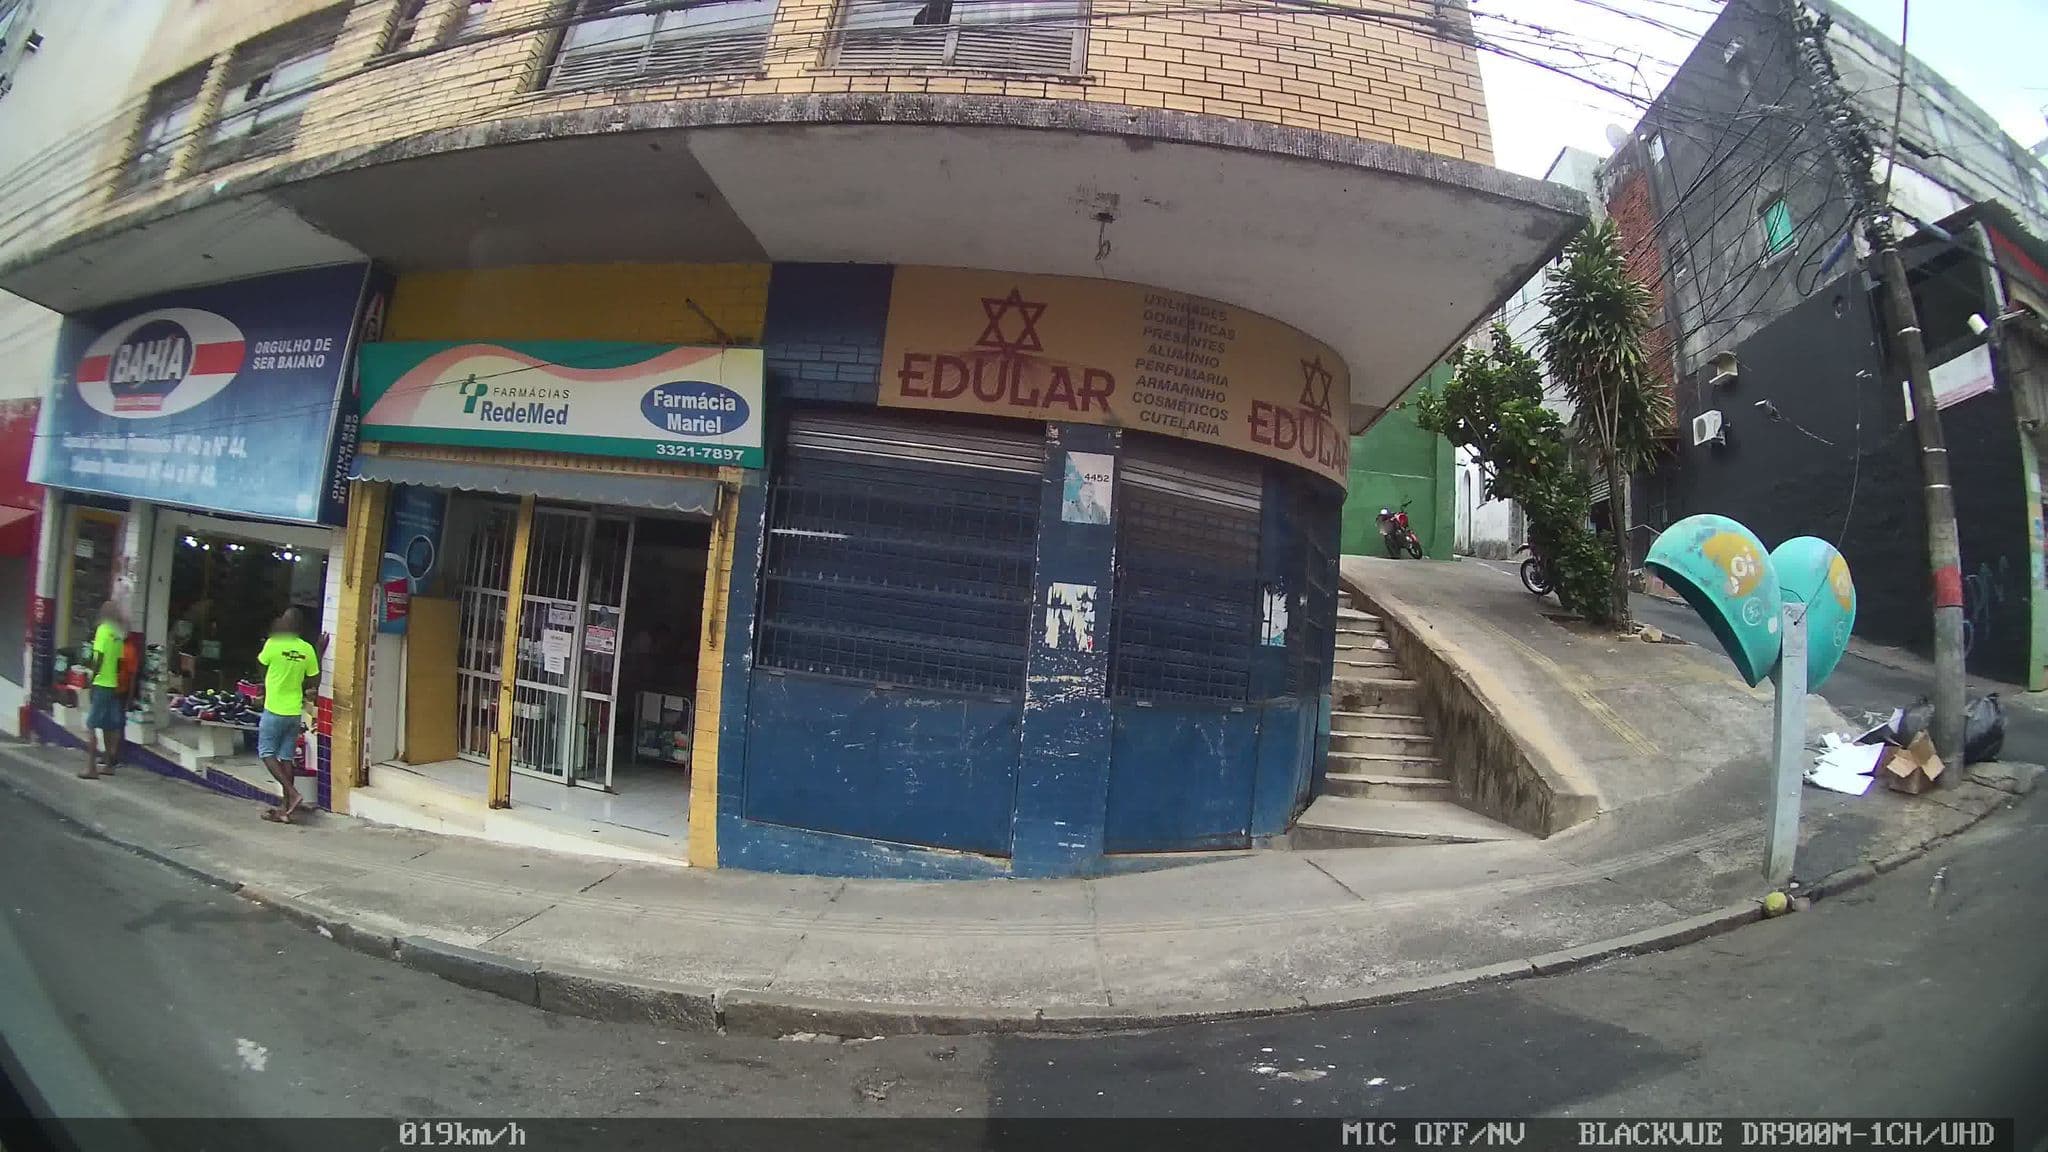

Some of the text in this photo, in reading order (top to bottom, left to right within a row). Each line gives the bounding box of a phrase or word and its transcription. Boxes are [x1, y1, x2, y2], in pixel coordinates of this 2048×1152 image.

[254, 337, 332, 354] ORGULHO DE
[1142, 327, 1226, 353] PRESENTES
[112, 337, 185, 383] BAHIA
[252, 354, 326, 370] SER BAIANO
[898, 352, 1116, 414] EDULAR
[1135, 358, 1229, 387] PERFUMARIA
[493, 386, 570, 399] FARMÁCIAS
[653, 389, 736, 411] Farmácia
[1135, 375, 1226, 403] ARMARINHO
[480, 401, 569, 426] RedeMed
[666, 412, 722, 433] Mariel
[1139, 410, 1220, 436] CUTELARIA
[656, 444, 745, 461] 3321-7897
[1084, 473, 1110, 483] 4452
